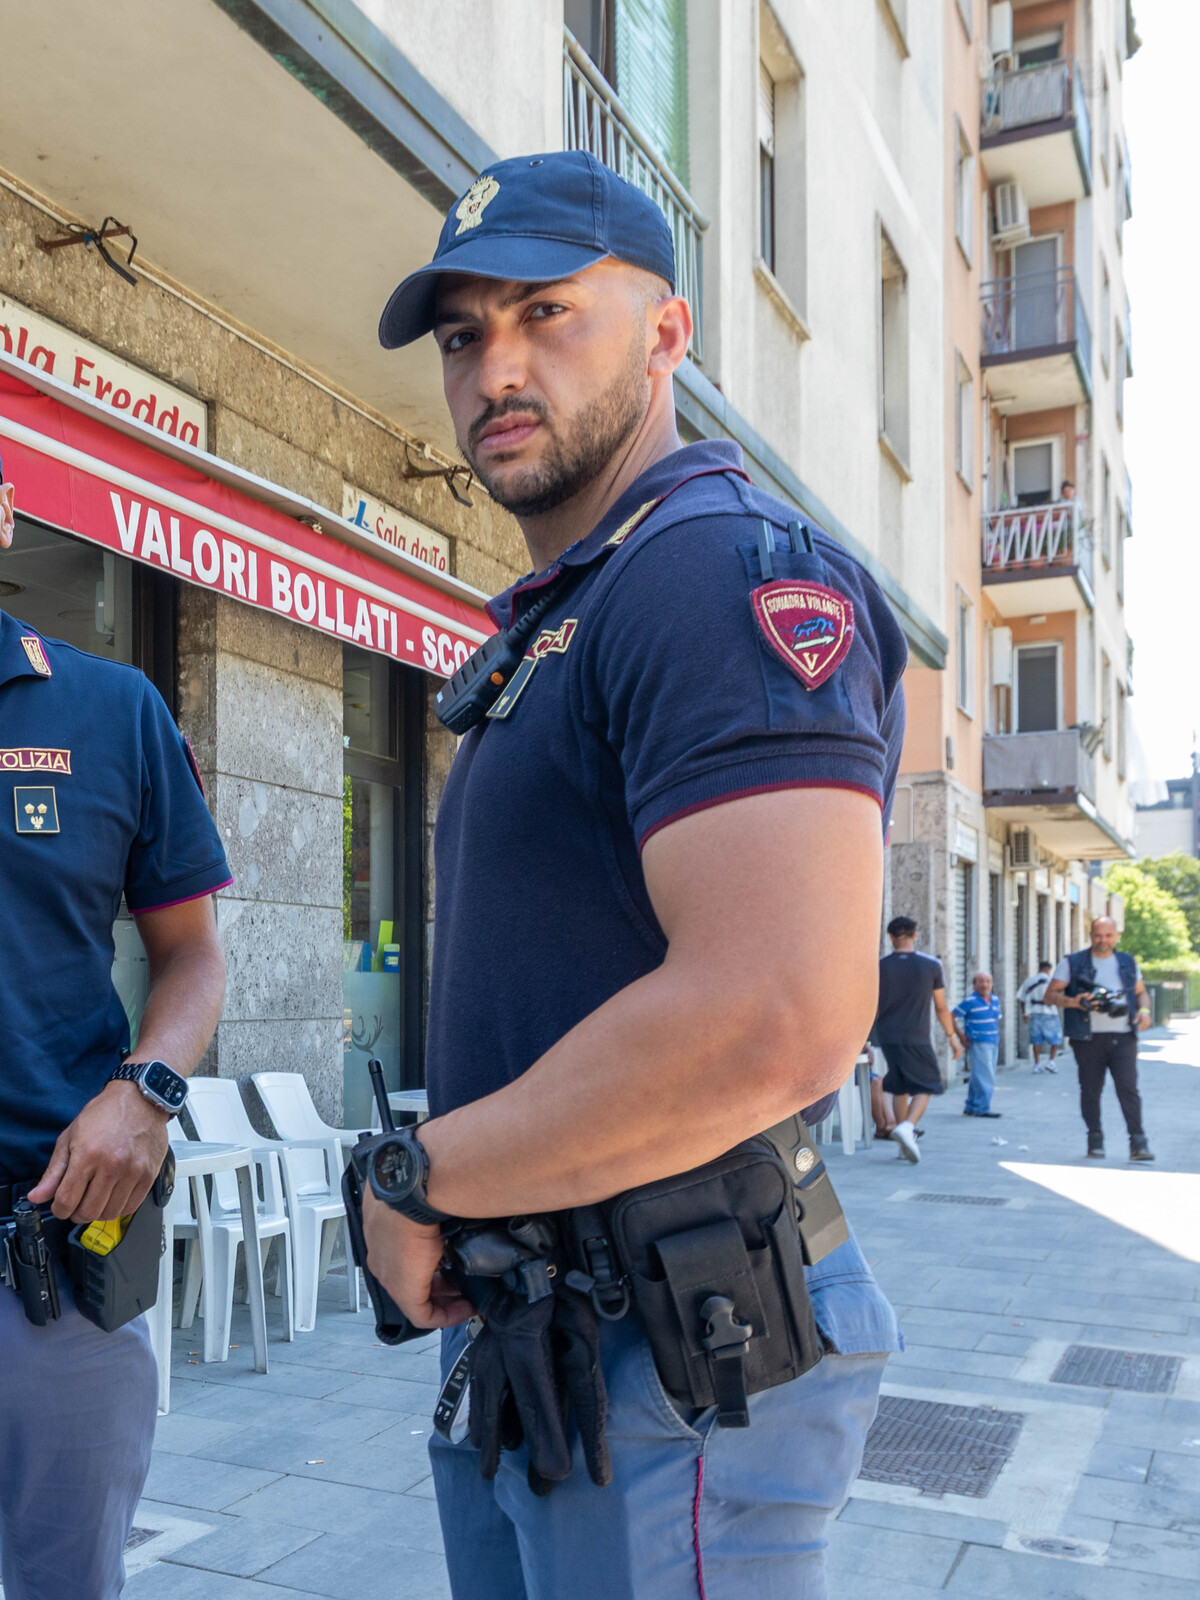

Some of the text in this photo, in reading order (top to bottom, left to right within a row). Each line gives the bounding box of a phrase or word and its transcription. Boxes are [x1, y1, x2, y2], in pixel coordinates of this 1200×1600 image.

[109, 490, 258, 602] VALORI
[270, 559, 399, 656] BOLLATI
[421, 625, 478, 676] SCO
[766, 593, 842, 620] SQUADRA VOLANTE
